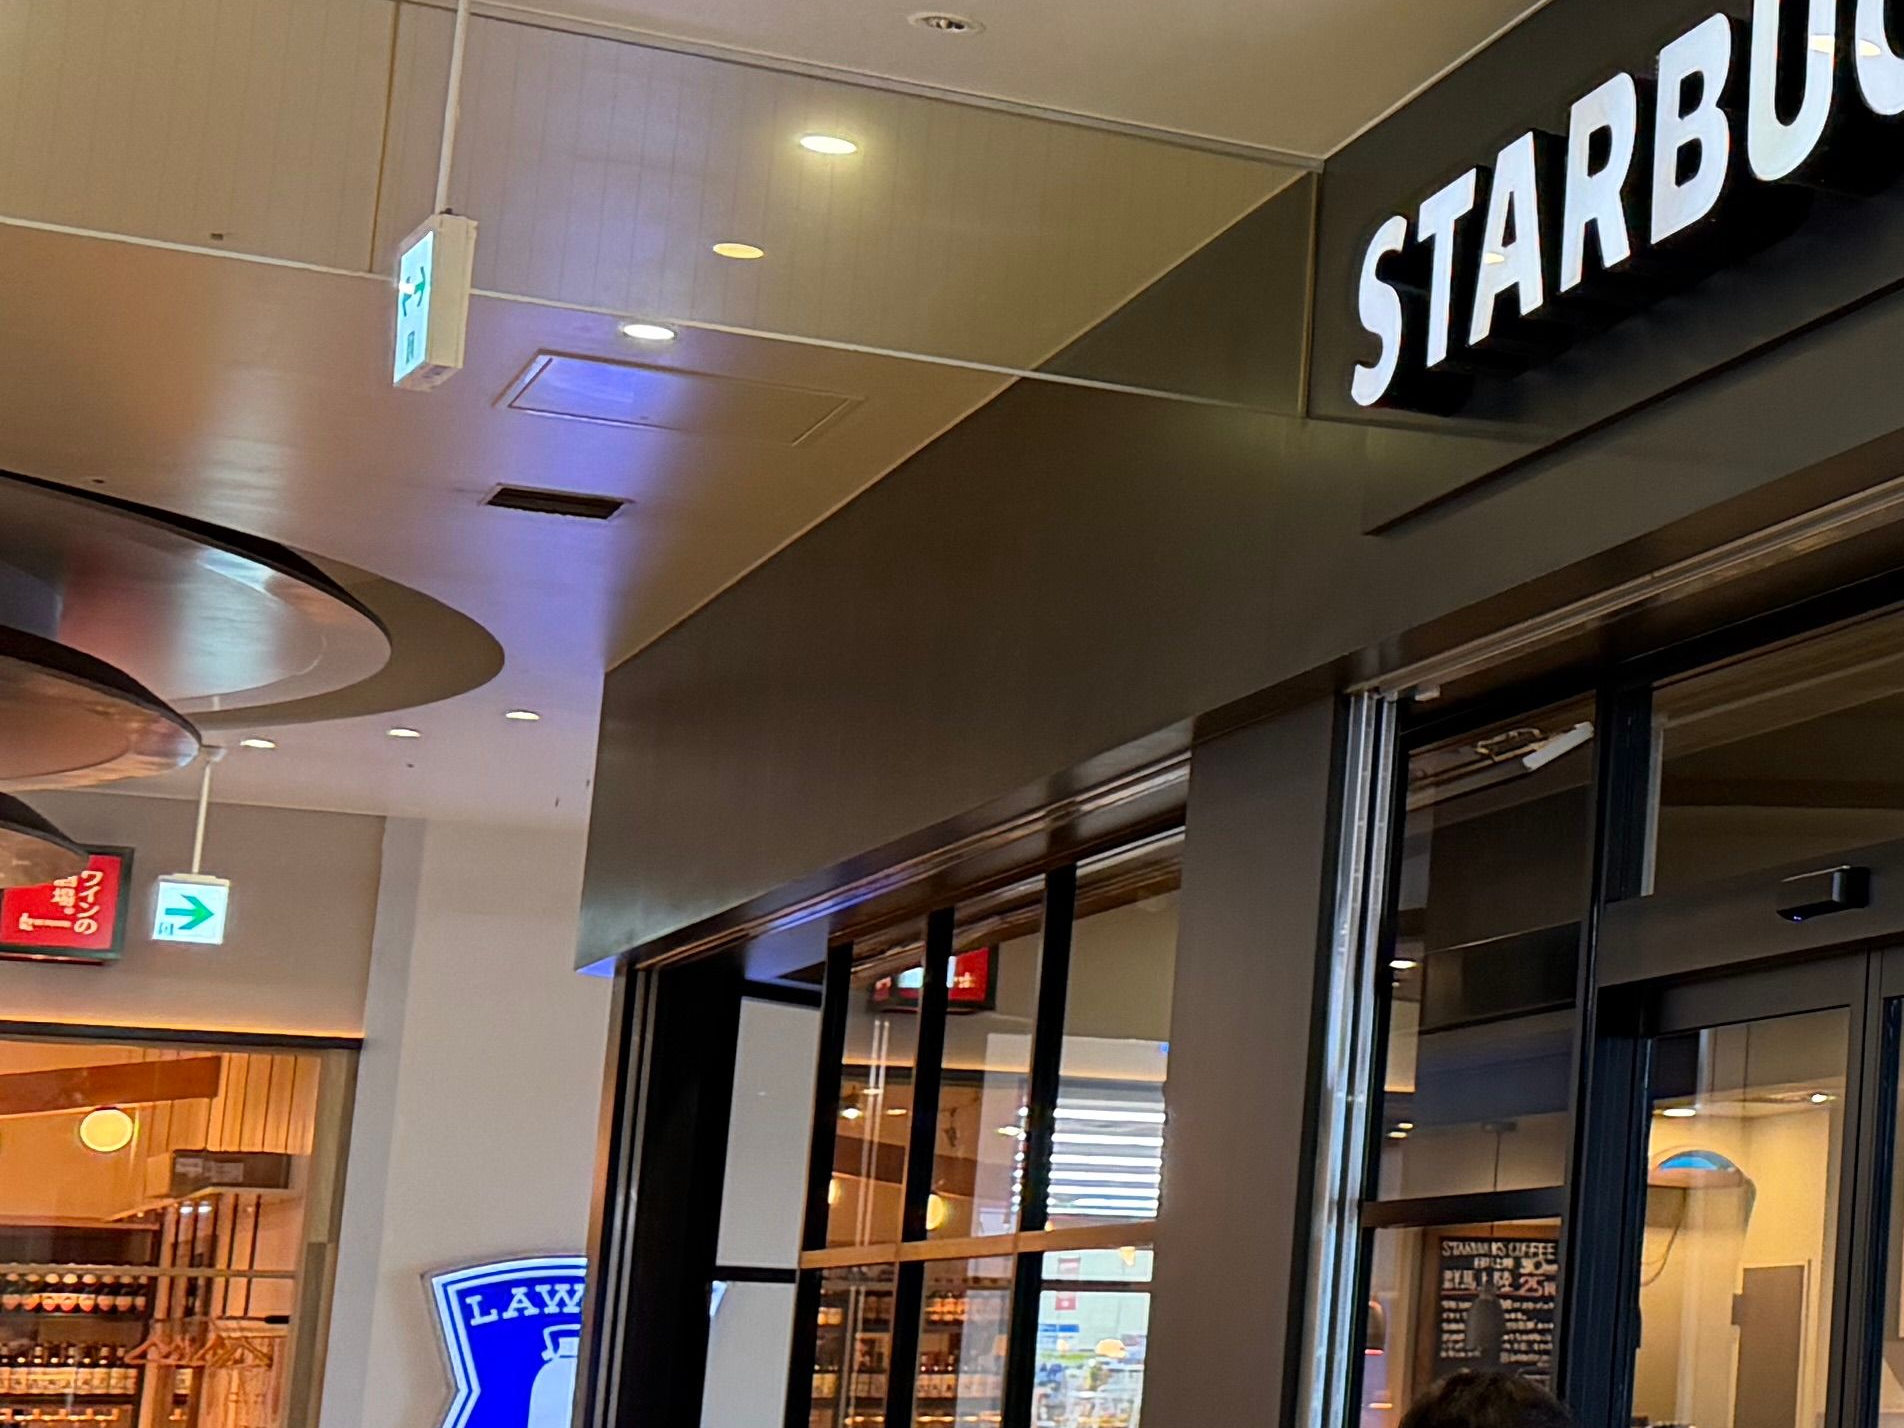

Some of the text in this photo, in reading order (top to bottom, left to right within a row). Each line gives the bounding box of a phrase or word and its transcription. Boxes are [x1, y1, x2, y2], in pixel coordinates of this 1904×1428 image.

[74, 870, 103, 935] ワインの
[465, 1283, 586, 1326] LAW
